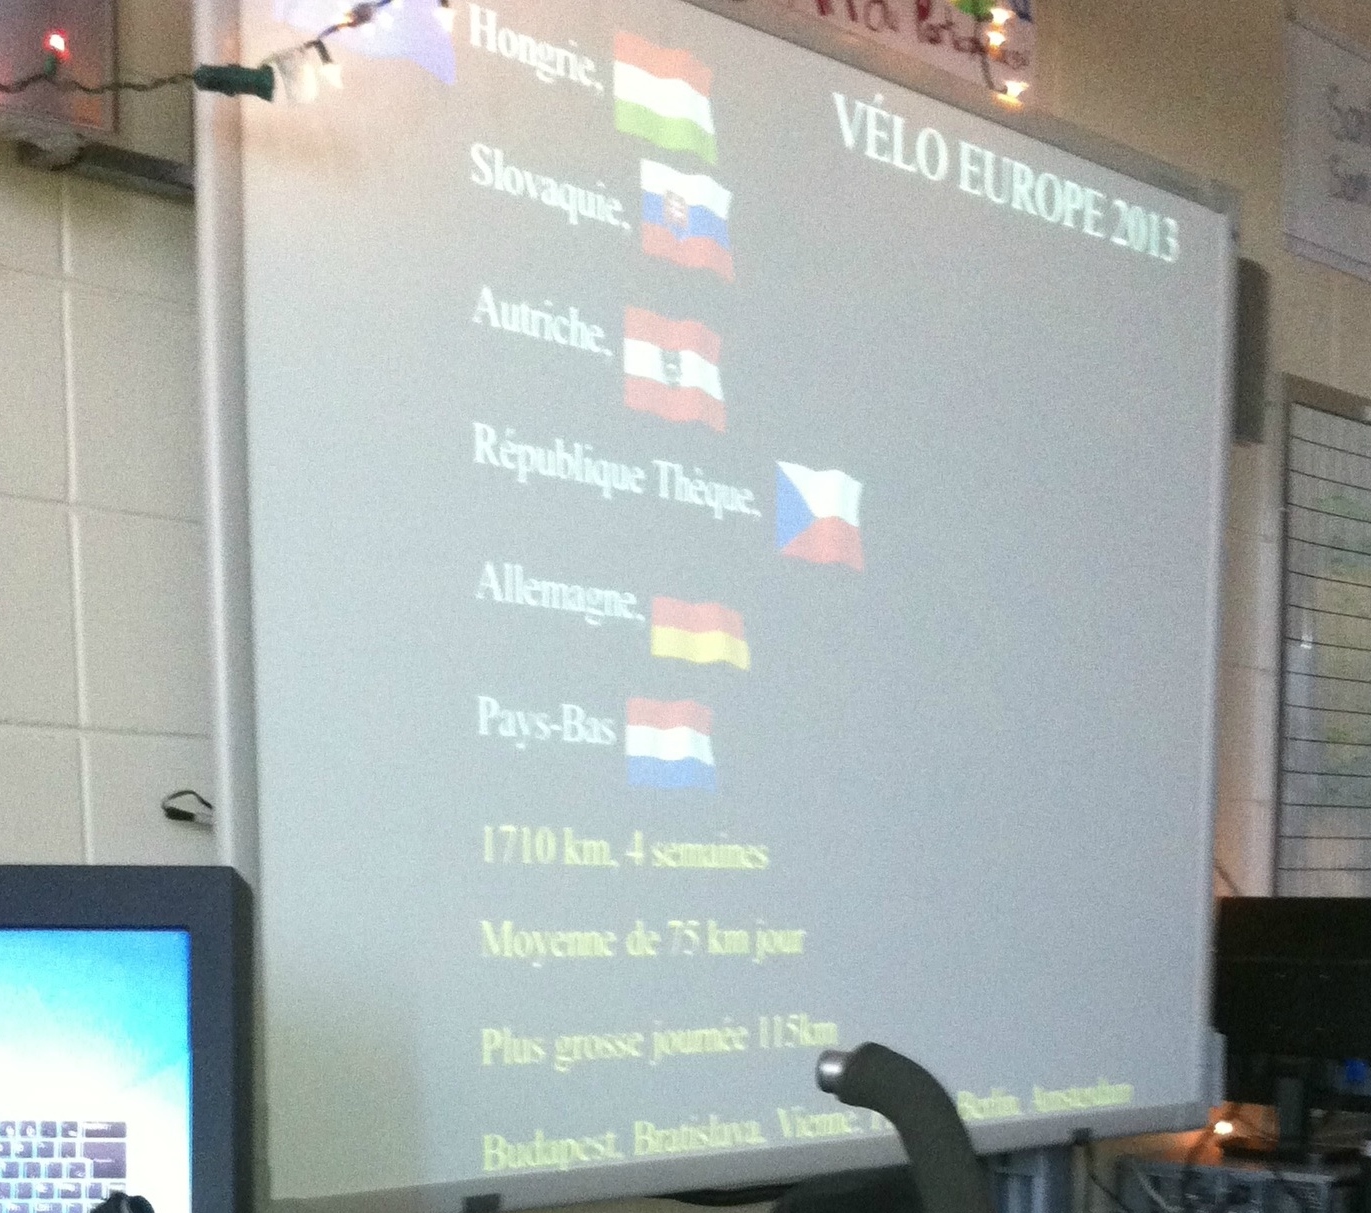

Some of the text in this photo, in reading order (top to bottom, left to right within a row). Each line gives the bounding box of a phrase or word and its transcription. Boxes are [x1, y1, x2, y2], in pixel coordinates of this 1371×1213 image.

[469, 4, 604, 94] Hongrie,
[470, 143, 631, 231] Slovaquie,
[832, 91, 1180, 263] VÉLO EUROPE 2013
[473, 287, 614, 356] Autriche,
[473, 421, 646, 498] République
[476, 561, 645, 625] Allemagne,
[477, 696, 617, 749] Pays-Bas
[484, 825, 557, 864] 1710
[625, 829, 644, 866] 4
[651, 832, 770, 869] semaines
[480, 918, 806, 968] Moyenne de 75 km jour
[482, 1027, 546, 1064] Plus
[555, 1032, 644, 1072] grosse
[649, 1018, 748, 1066] journée
